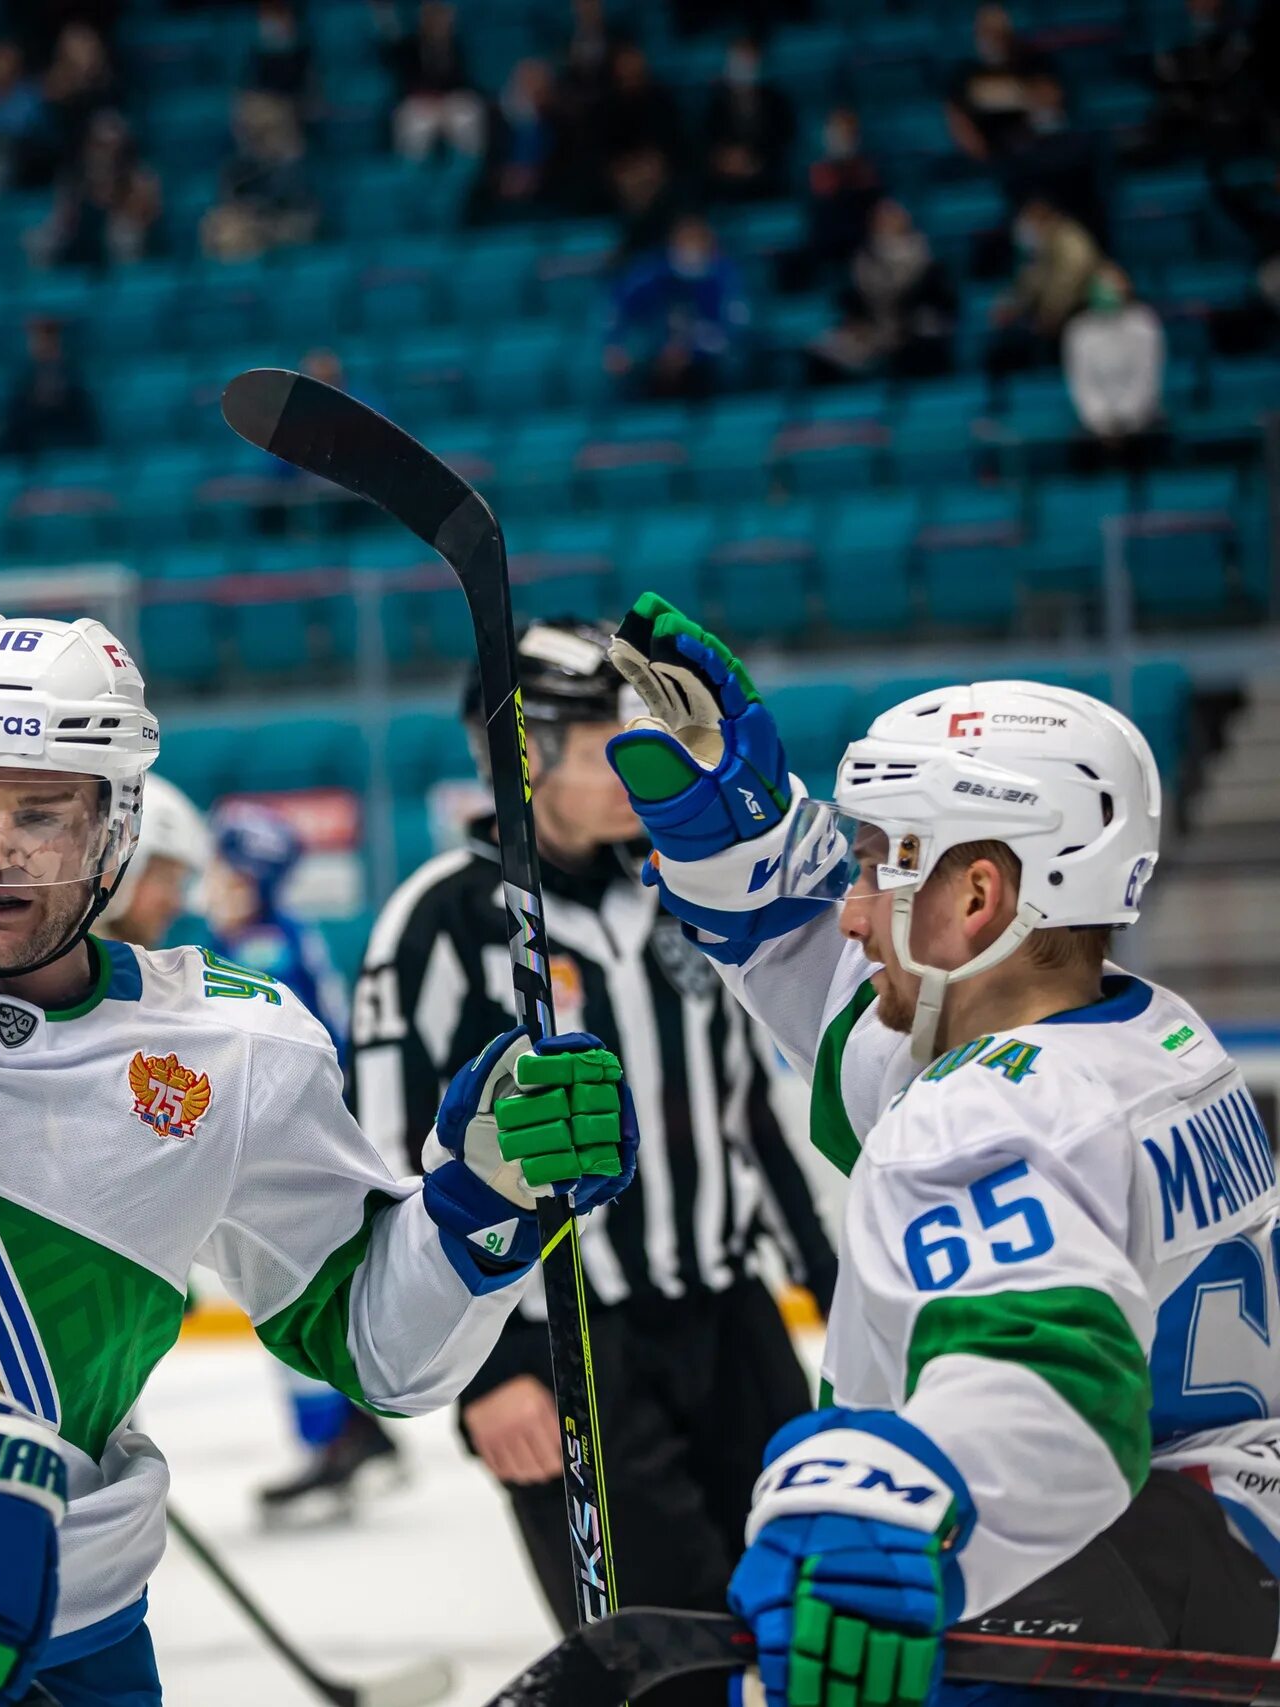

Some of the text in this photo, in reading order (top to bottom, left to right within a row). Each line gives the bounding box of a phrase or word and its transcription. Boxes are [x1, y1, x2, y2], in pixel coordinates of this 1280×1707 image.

[142, 726, 159, 742] CCM
[991, 714, 1068, 728] СТРОИТЭК
[146, 1077, 186, 1124] 75
[903, 1158, 1055, 1291] 65
[758, 1458, 937, 1505] CM
[979, 1616, 1082, 1635] CCM
